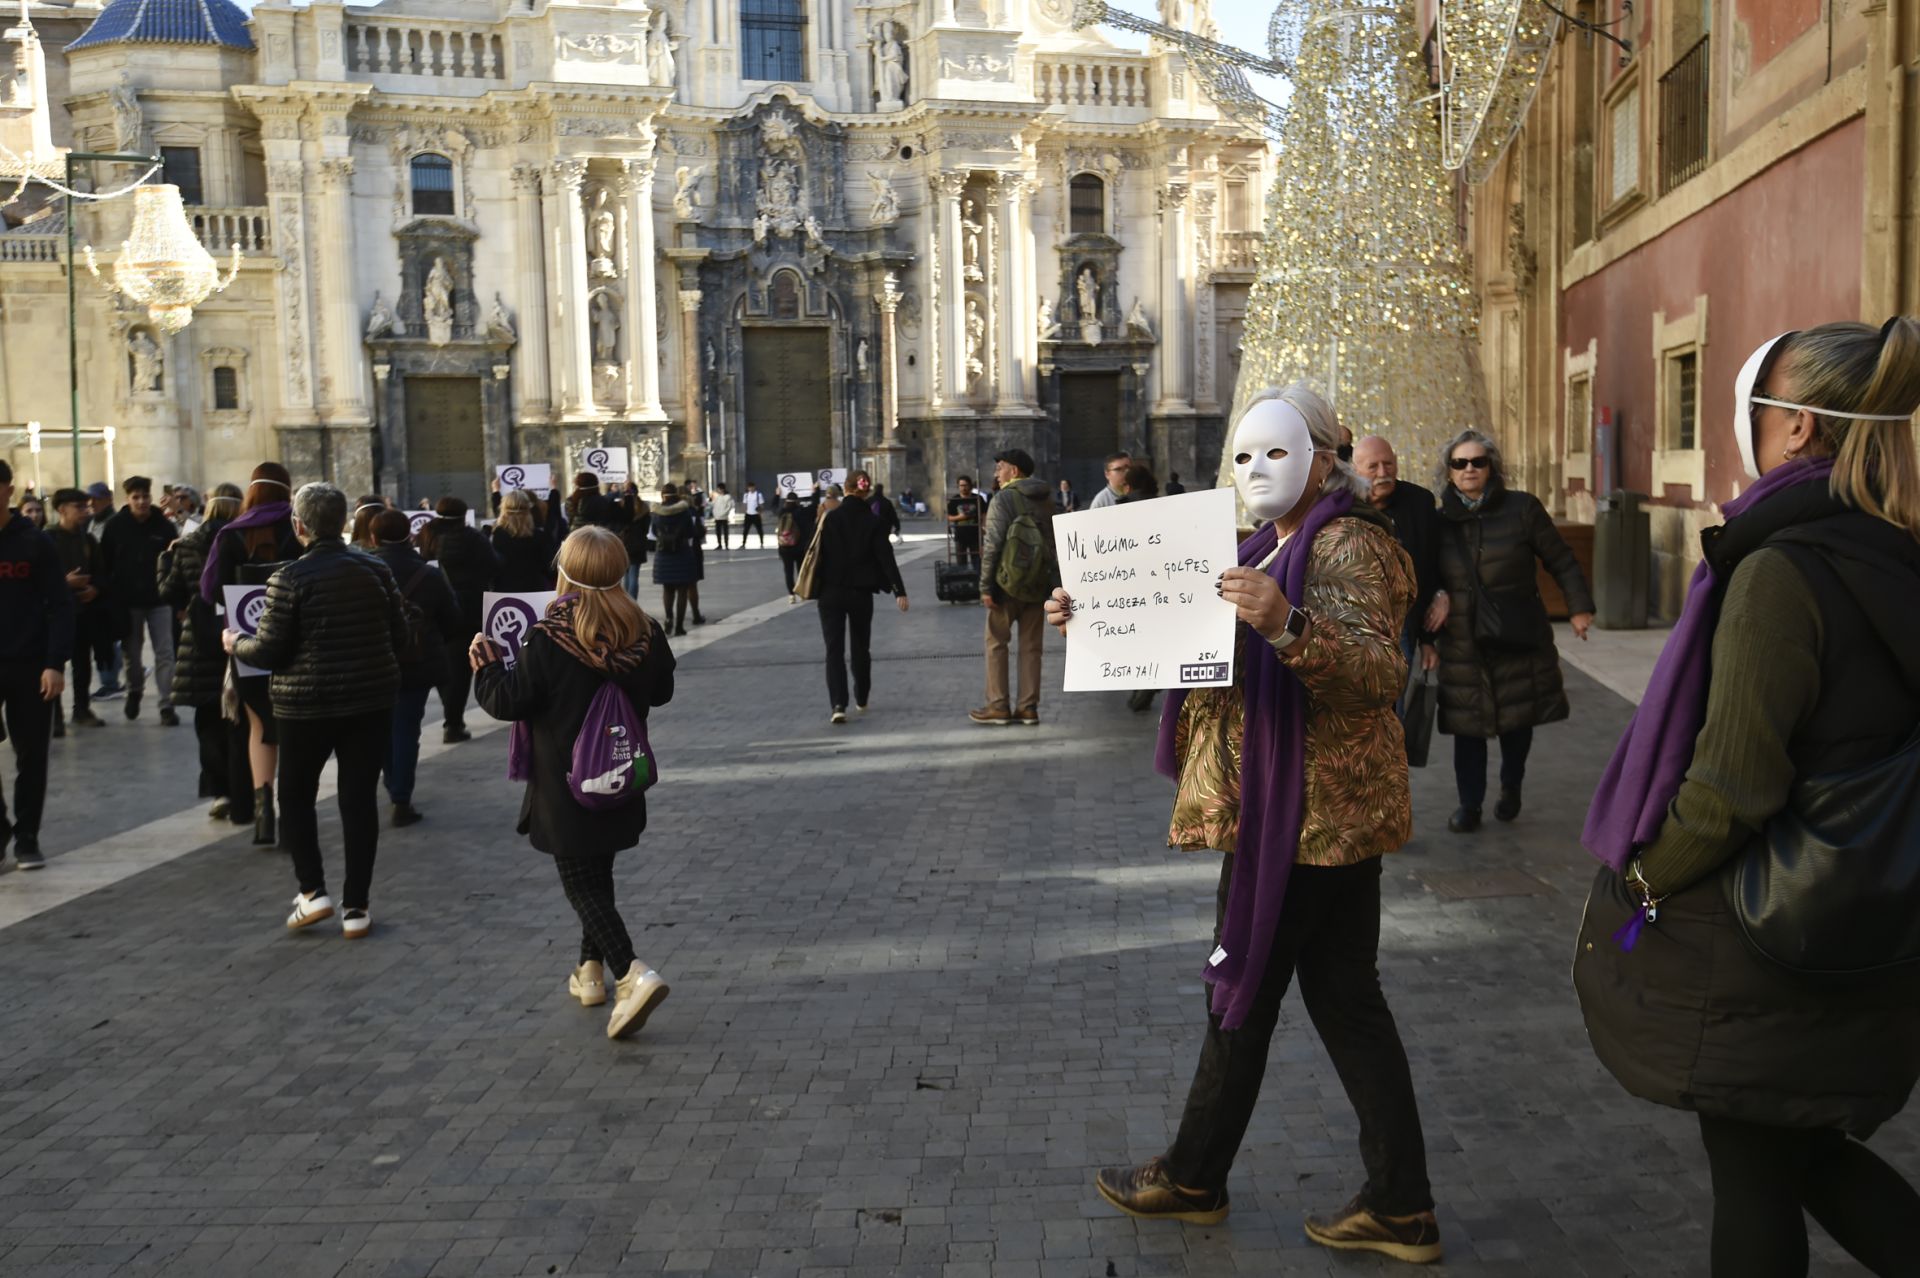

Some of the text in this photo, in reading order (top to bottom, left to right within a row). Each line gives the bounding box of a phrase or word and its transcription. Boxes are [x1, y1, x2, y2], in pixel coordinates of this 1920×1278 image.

[1067, 530, 1087, 560] Mi
[1080, 566, 1136, 583] ASESINADA
[1164, 558, 1209, 580] GOLPES
[1106, 597, 1146, 610] CABEZA
[1100, 662, 1131, 678] BASTA
[1182, 665, 1215, 681] CCOO
